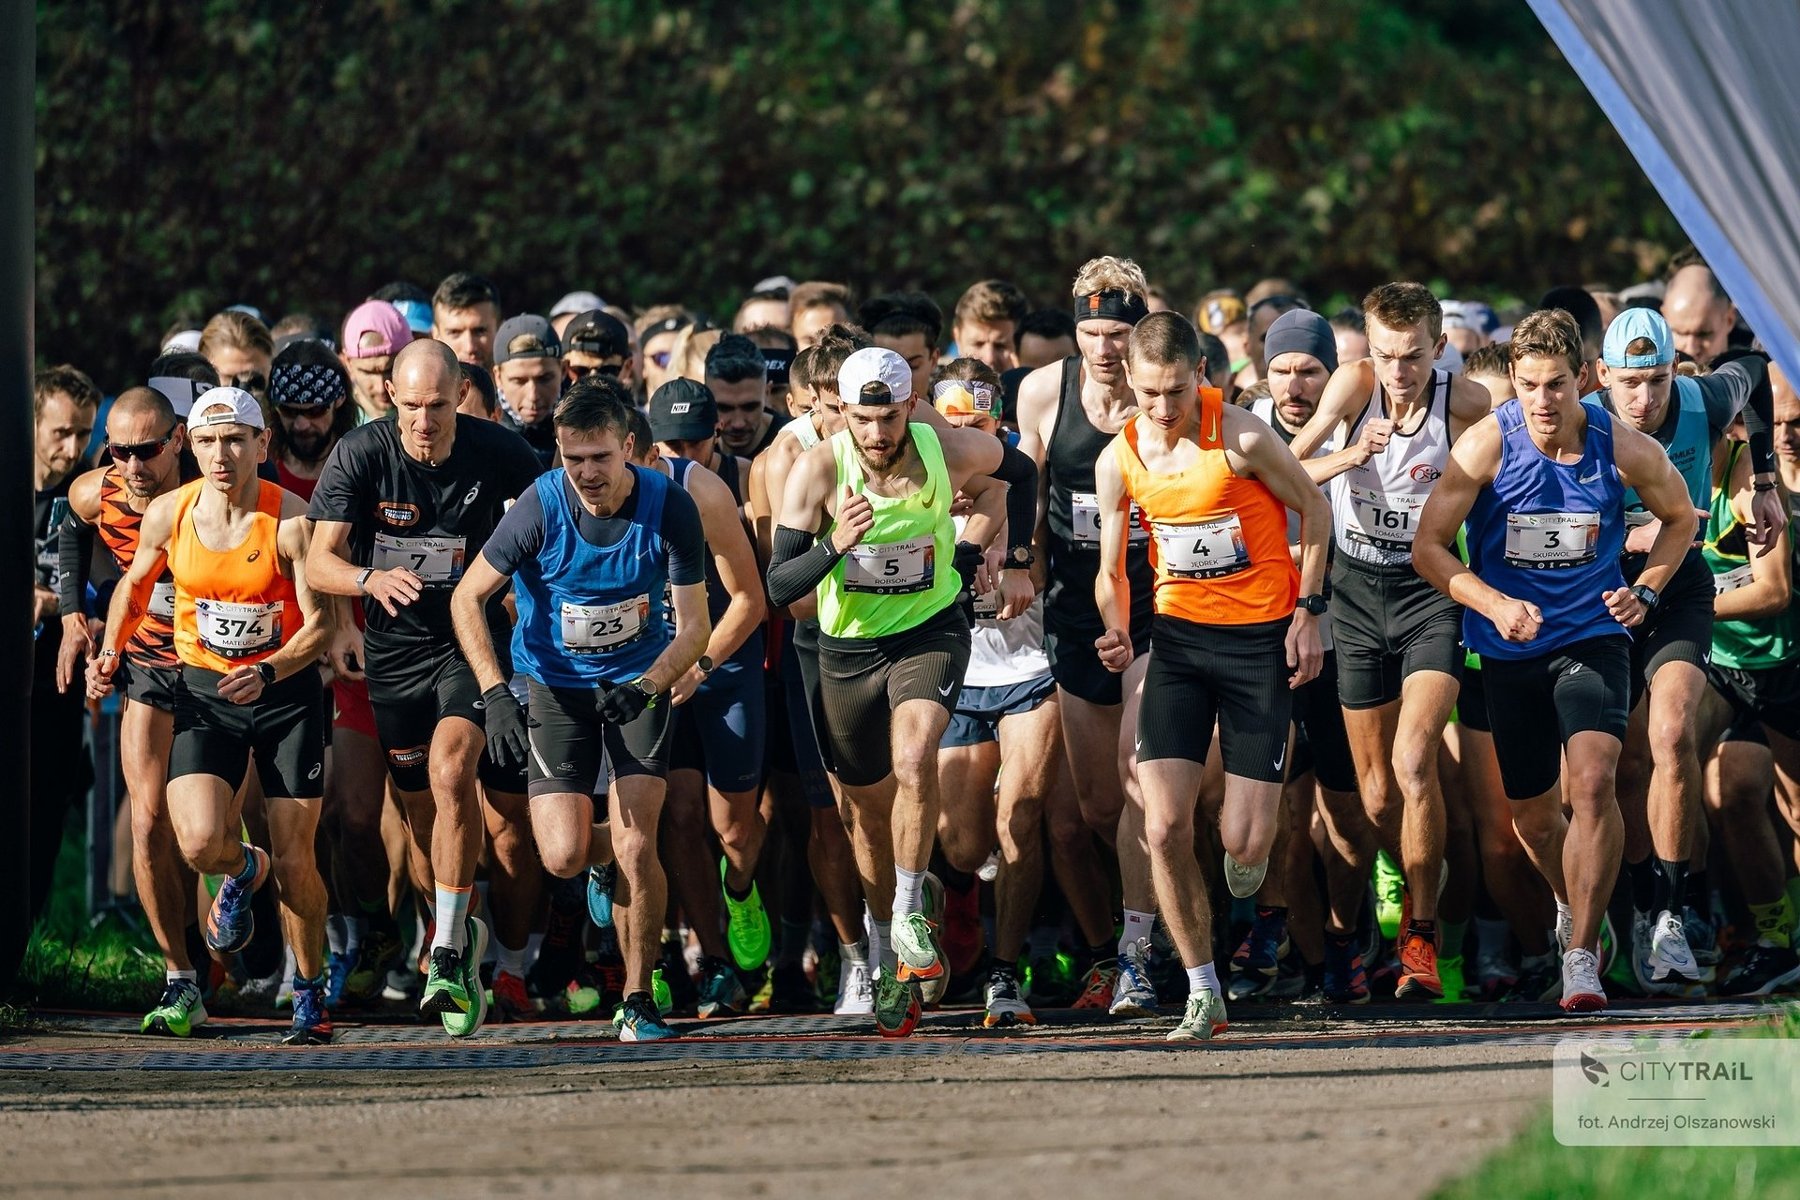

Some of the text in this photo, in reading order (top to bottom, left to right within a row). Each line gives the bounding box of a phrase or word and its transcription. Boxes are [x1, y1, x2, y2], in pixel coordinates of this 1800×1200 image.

[672, 404, 688, 412] NIKE
[1372, 507, 1410, 530] 161
[1374, 529, 1405, 539] TOMASZ
[1543, 530, 1561, 549] 3
[1192, 538, 1211, 557] 4
[410, 553, 428, 571] 7
[883, 558, 900, 577] 5
[874, 577, 907, 586] ROBSON
[215, 617, 265, 638] 374
[591, 616, 624, 637] 23
[222, 639, 257, 647] MATEUSZ
